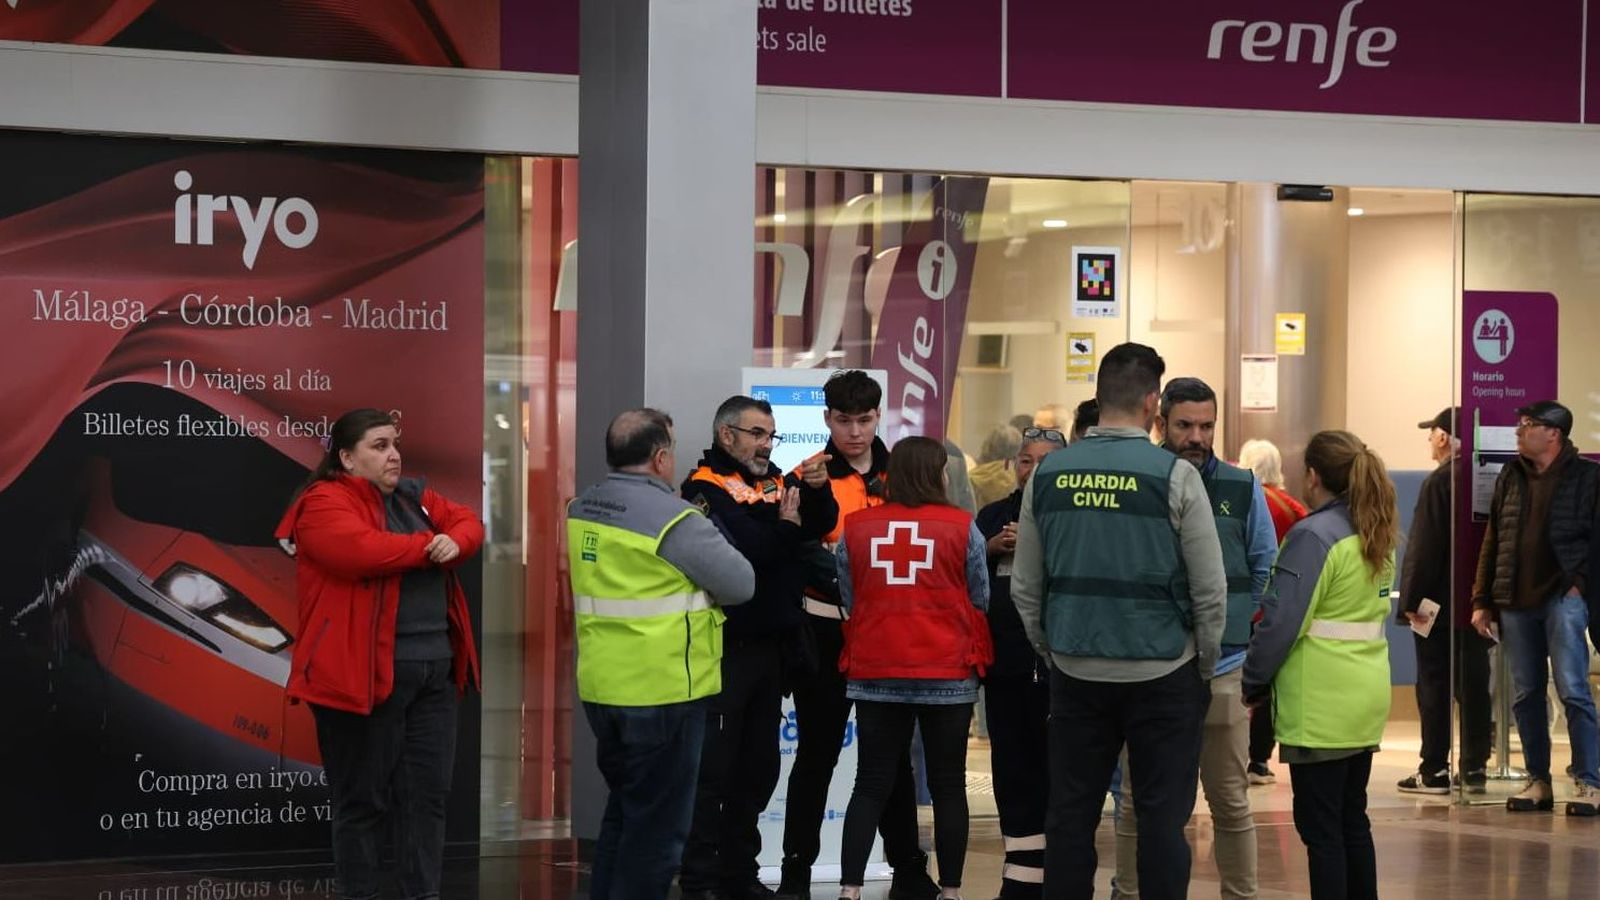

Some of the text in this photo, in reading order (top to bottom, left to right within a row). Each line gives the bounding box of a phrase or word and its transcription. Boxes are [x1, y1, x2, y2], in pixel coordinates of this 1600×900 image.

[823, 0, 912, 17] Billetes
[786, 26, 827, 53] sale
[1207, 0, 1398, 89] renfe
[174, 170, 319, 270] iryo
[936, 206, 974, 231] renfe
[33, 289, 147, 330] Málaga
[180, 293, 312, 328] Córdoba
[342, 298, 449, 332] Madrid
[162, 359, 332, 394] 10 viajes al día
[898, 316, 939, 438] nfe
[1472, 371, 1505, 382] Horario
[1472, 386, 1526, 398] Opening hours
[83, 412, 169, 436] Billetes
[176, 413, 269, 438] flexibles
[781, 432, 828, 444] BIENVEN
[1056, 474, 1138, 491] GUARDIA
[1073, 492, 1120, 508] CIVIL
[138, 766, 329, 796] Compra en iryo.e
[100, 799, 333, 831] o en tu agencia de vi
